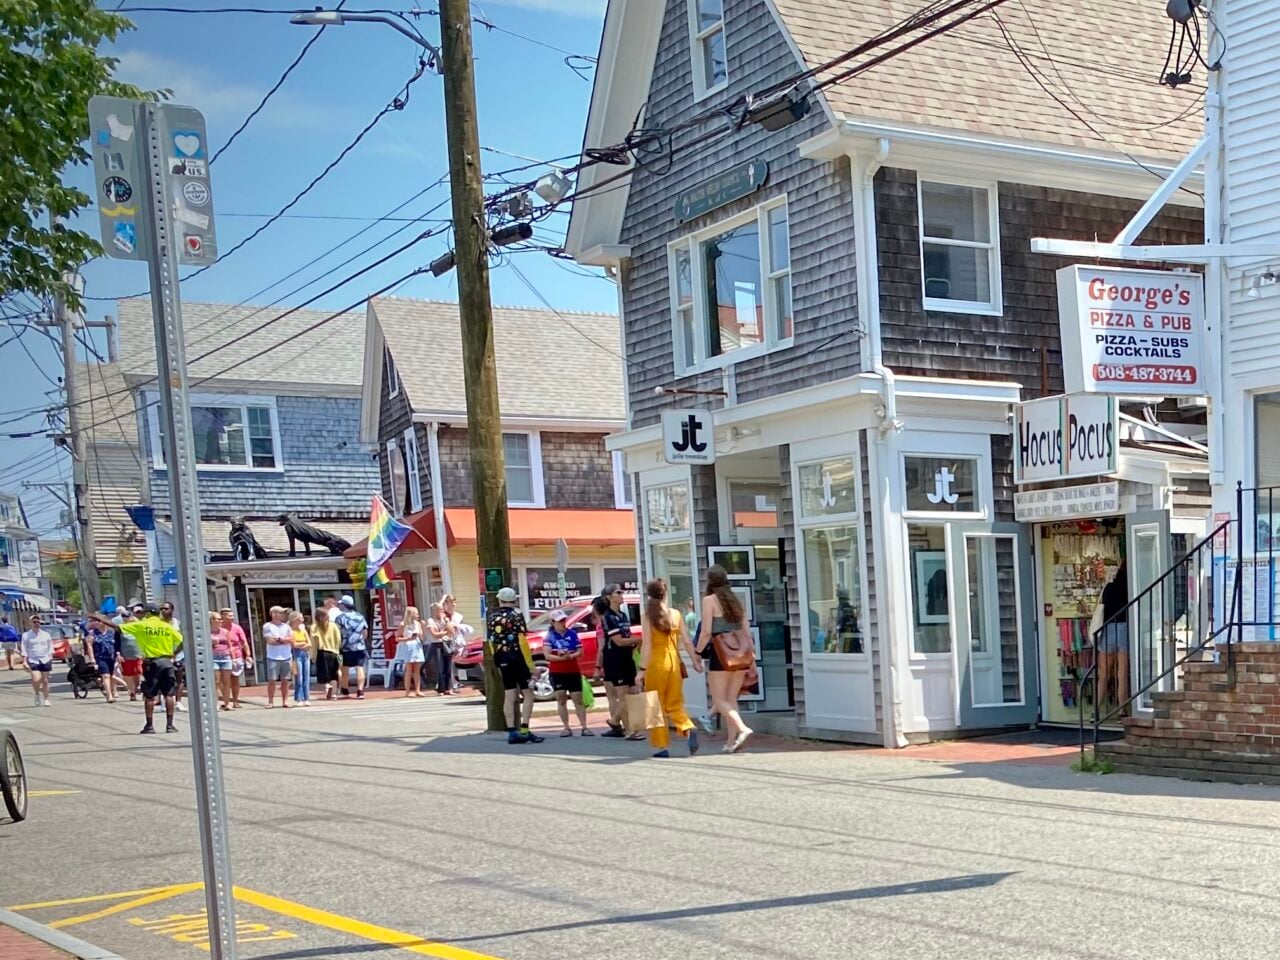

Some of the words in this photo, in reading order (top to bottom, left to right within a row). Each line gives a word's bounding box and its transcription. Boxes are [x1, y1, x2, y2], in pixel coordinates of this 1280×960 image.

[1088, 276, 1191, 310] George's
[1090, 311, 1136, 328] PIZZA
[1143, 314, 1154, 329] &
[1161, 316, 1192, 330] PUB
[1095, 334, 1137, 346] PIZZA
[1151, 337, 1189, 348] SUBS
[1105, 346, 1182, 359] COCKTAILS
[1098, 365, 1192, 382] 508-487-3744
